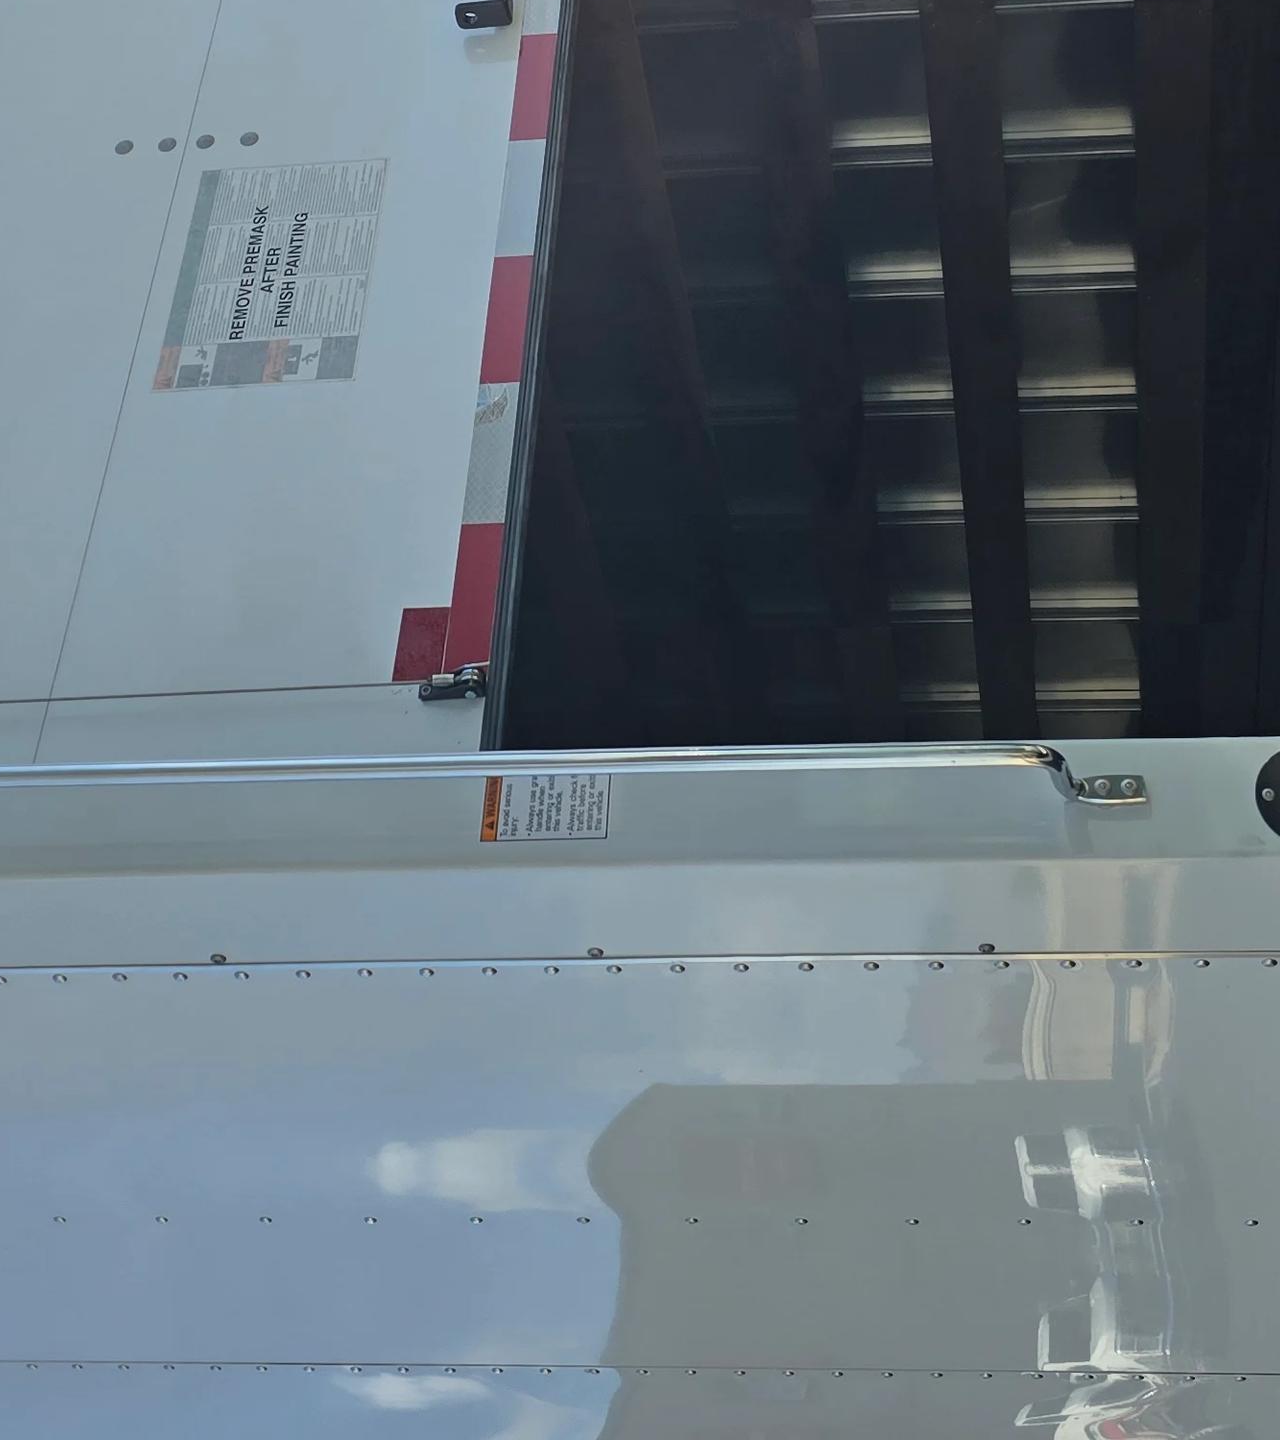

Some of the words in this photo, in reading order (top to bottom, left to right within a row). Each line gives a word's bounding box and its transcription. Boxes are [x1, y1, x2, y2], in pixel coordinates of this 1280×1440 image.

[284, 212, 308, 276] PAINTING
[229, 278, 254, 340] REMOVE
[242, 205, 268, 274] PREMASK
[260, 247, 281, 293] AFTER
[274, 281, 296, 328] FINISH
[486, 776, 499, 818] WARNIN
[526, 804, 536, 832] Always
[566, 804, 577, 832] Always
[500, 829, 508, 837] To
